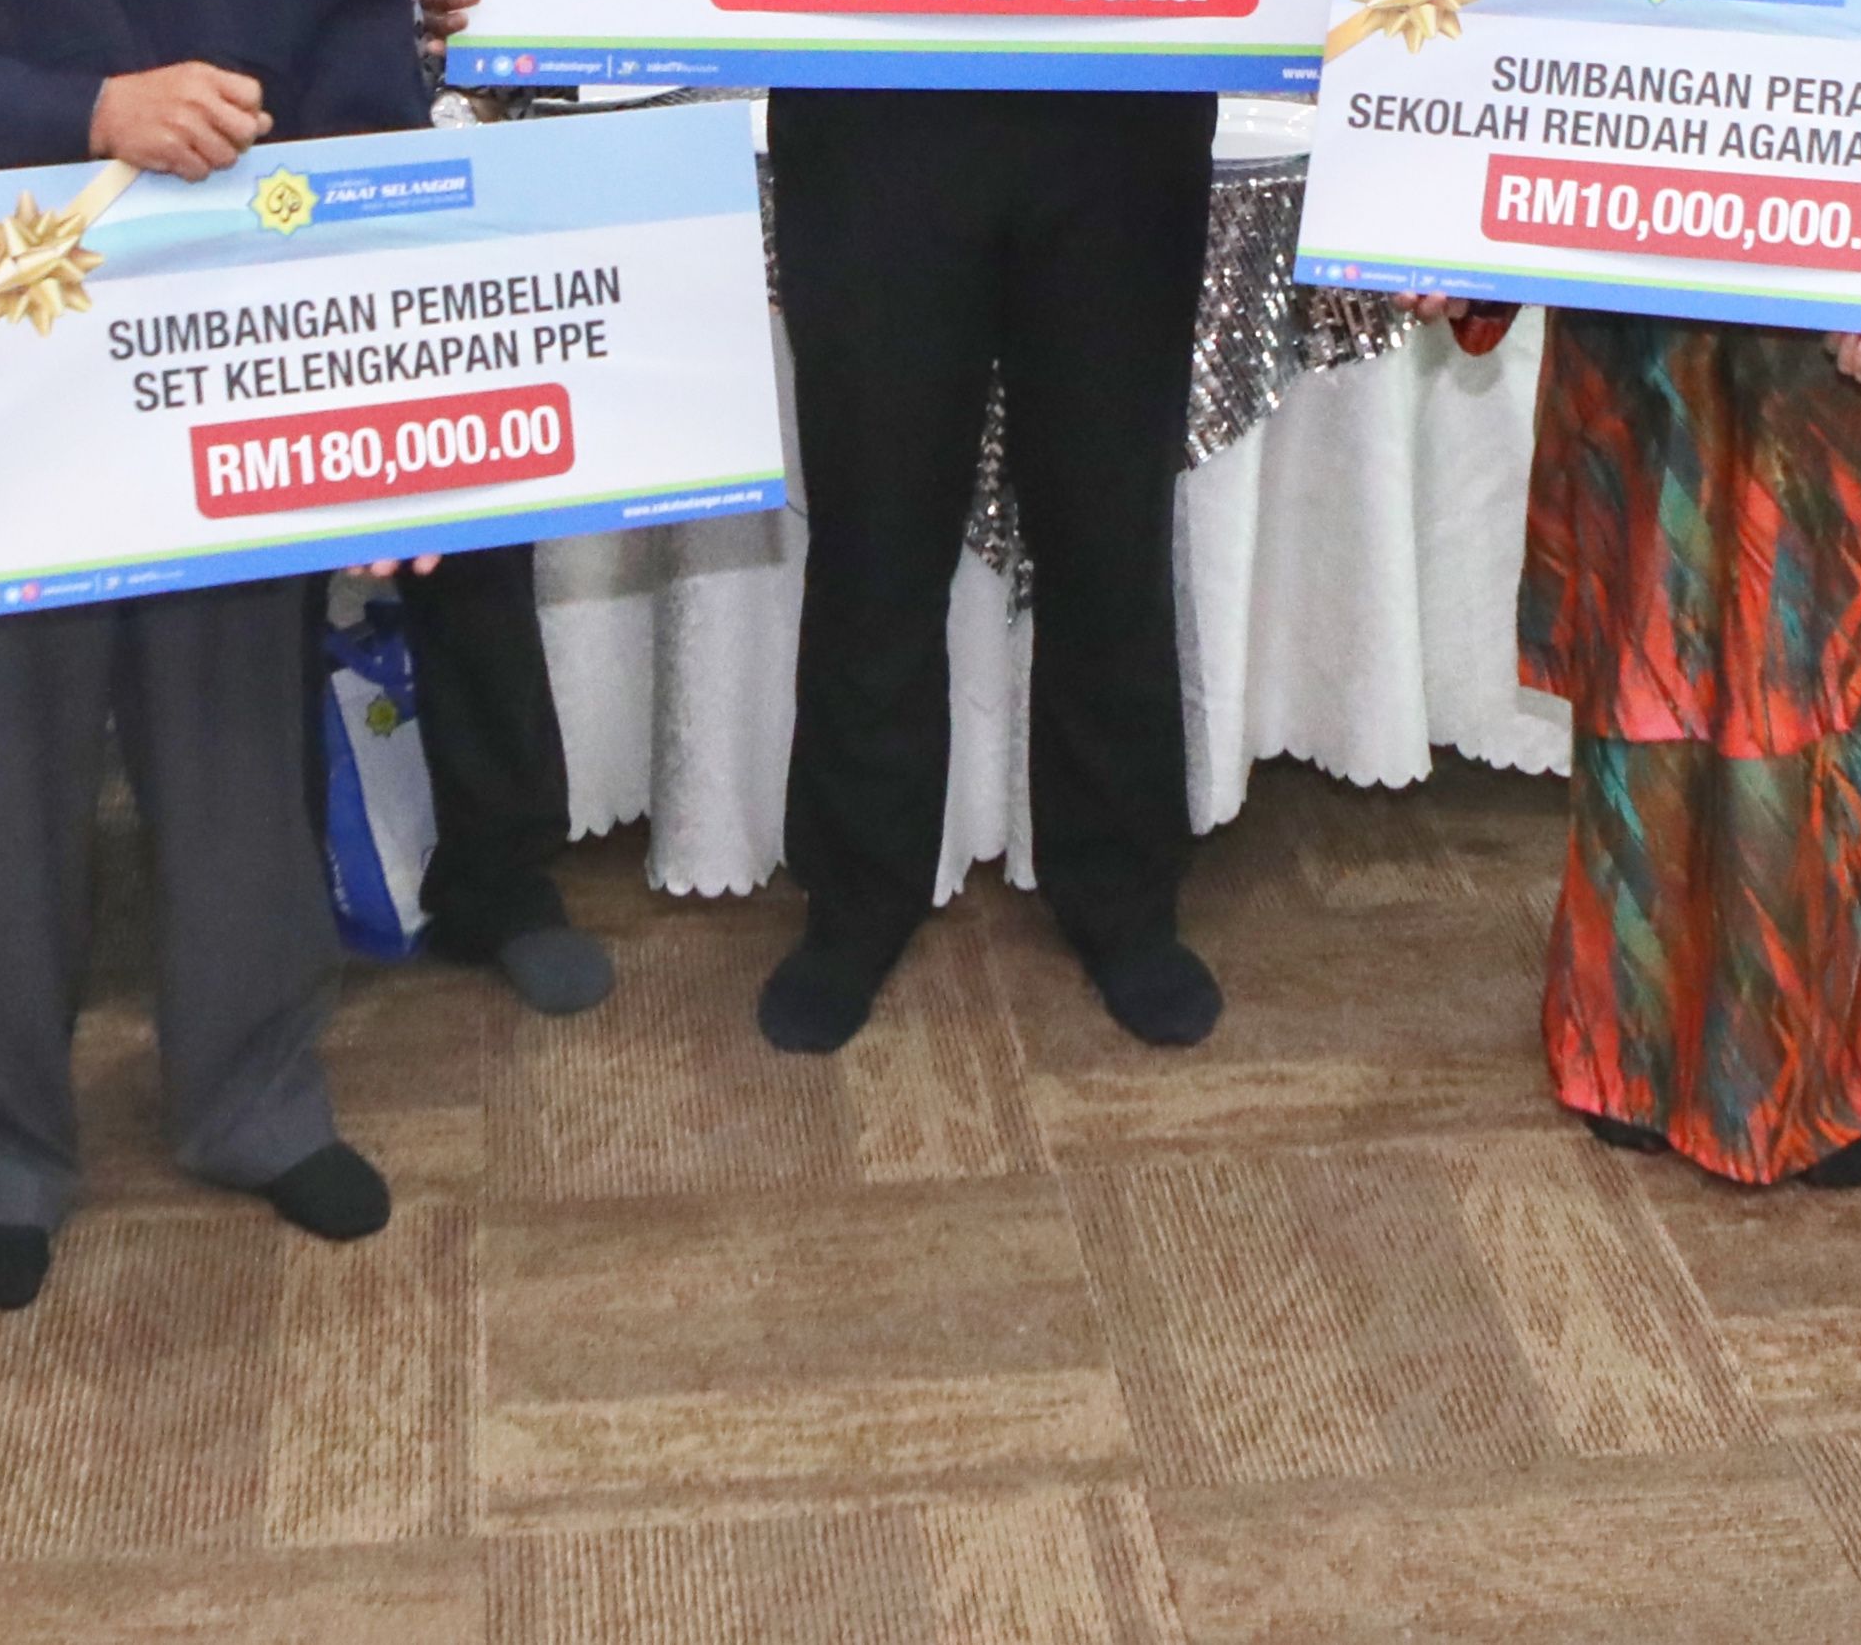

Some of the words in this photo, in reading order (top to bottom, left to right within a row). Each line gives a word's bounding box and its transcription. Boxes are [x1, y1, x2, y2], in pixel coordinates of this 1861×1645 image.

[1349, 94, 1527, 138] SEKOLAH
[1545, 110, 1705, 151] RENDAH
[1494, 57, 1749, 107] SUMBANGAN
[110, 295, 374, 359] SUMBANGAN
[393, 268, 619, 326] PEMBELIAN
[135, 367, 206, 410] SET
[227, 331, 517, 398] KELENGKAPAN
[535, 321, 606, 363] PPE
[207, 405, 561, 496] RM180,000.00
